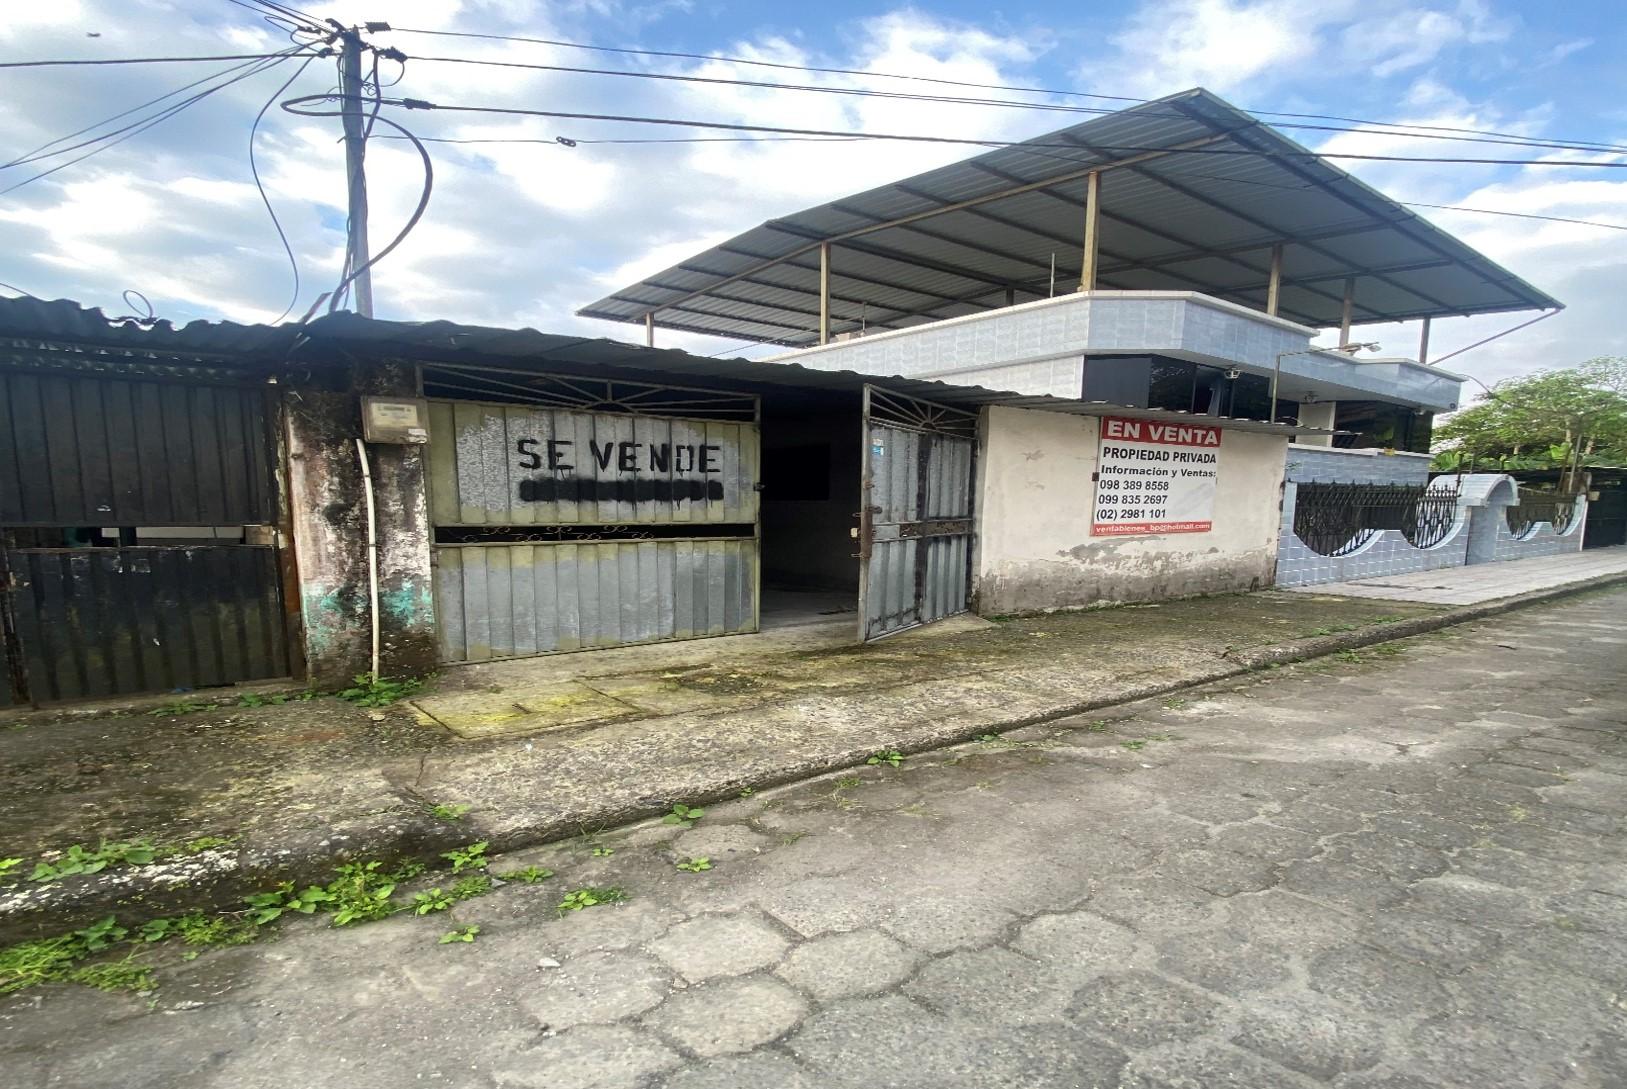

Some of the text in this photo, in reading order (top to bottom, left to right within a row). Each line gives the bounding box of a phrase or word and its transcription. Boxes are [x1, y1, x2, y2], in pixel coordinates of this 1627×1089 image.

[1107, 420, 1218, 445] EN VENTA
[517, 439, 721, 473] SE VENDE
[1103, 446, 1216, 464] PROPIEDAD PRIVADA
[1101, 465, 1216, 478] Información y Ventas:
[1100, 480, 1169, 490] 098 389 8558
[1098, 495, 1168, 504] 099 835 2697
[1096, 509, 1166, 520] (02) 2981 101
